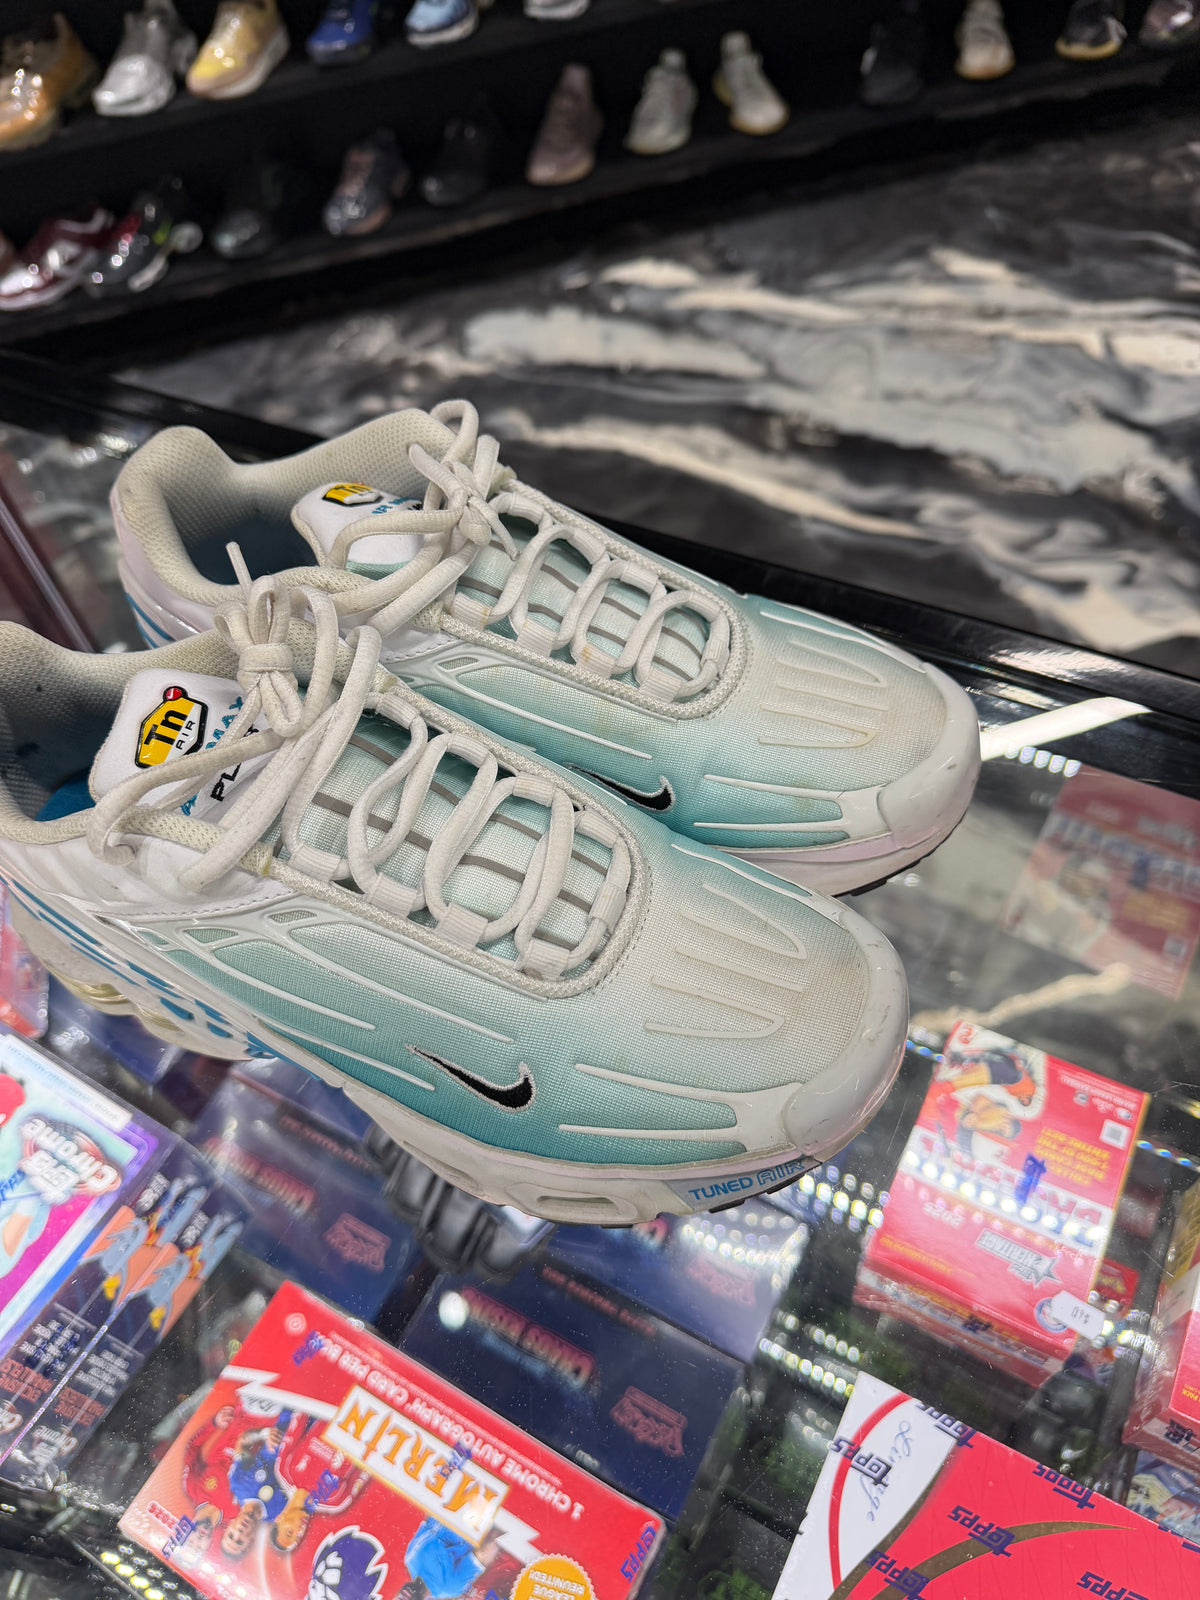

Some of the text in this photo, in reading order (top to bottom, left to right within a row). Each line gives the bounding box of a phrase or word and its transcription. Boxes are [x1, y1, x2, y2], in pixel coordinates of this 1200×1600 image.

[144, 710, 188, 746] Tn
[176, 720, 196, 750] AIR
[20, 1116, 120, 1193] Chrome
[688, 1160, 805, 1201] TUNED AIR
[337, 1349, 371, 1382] PER
[366, 1368, 409, 1404] CARD
[338, 1399, 499, 1533] MERLIN
[501, 1455, 573, 1515] CHROME
[946, 1504, 1017, 1558] topps
[528, 1569, 586, 1595] REUNITED!
